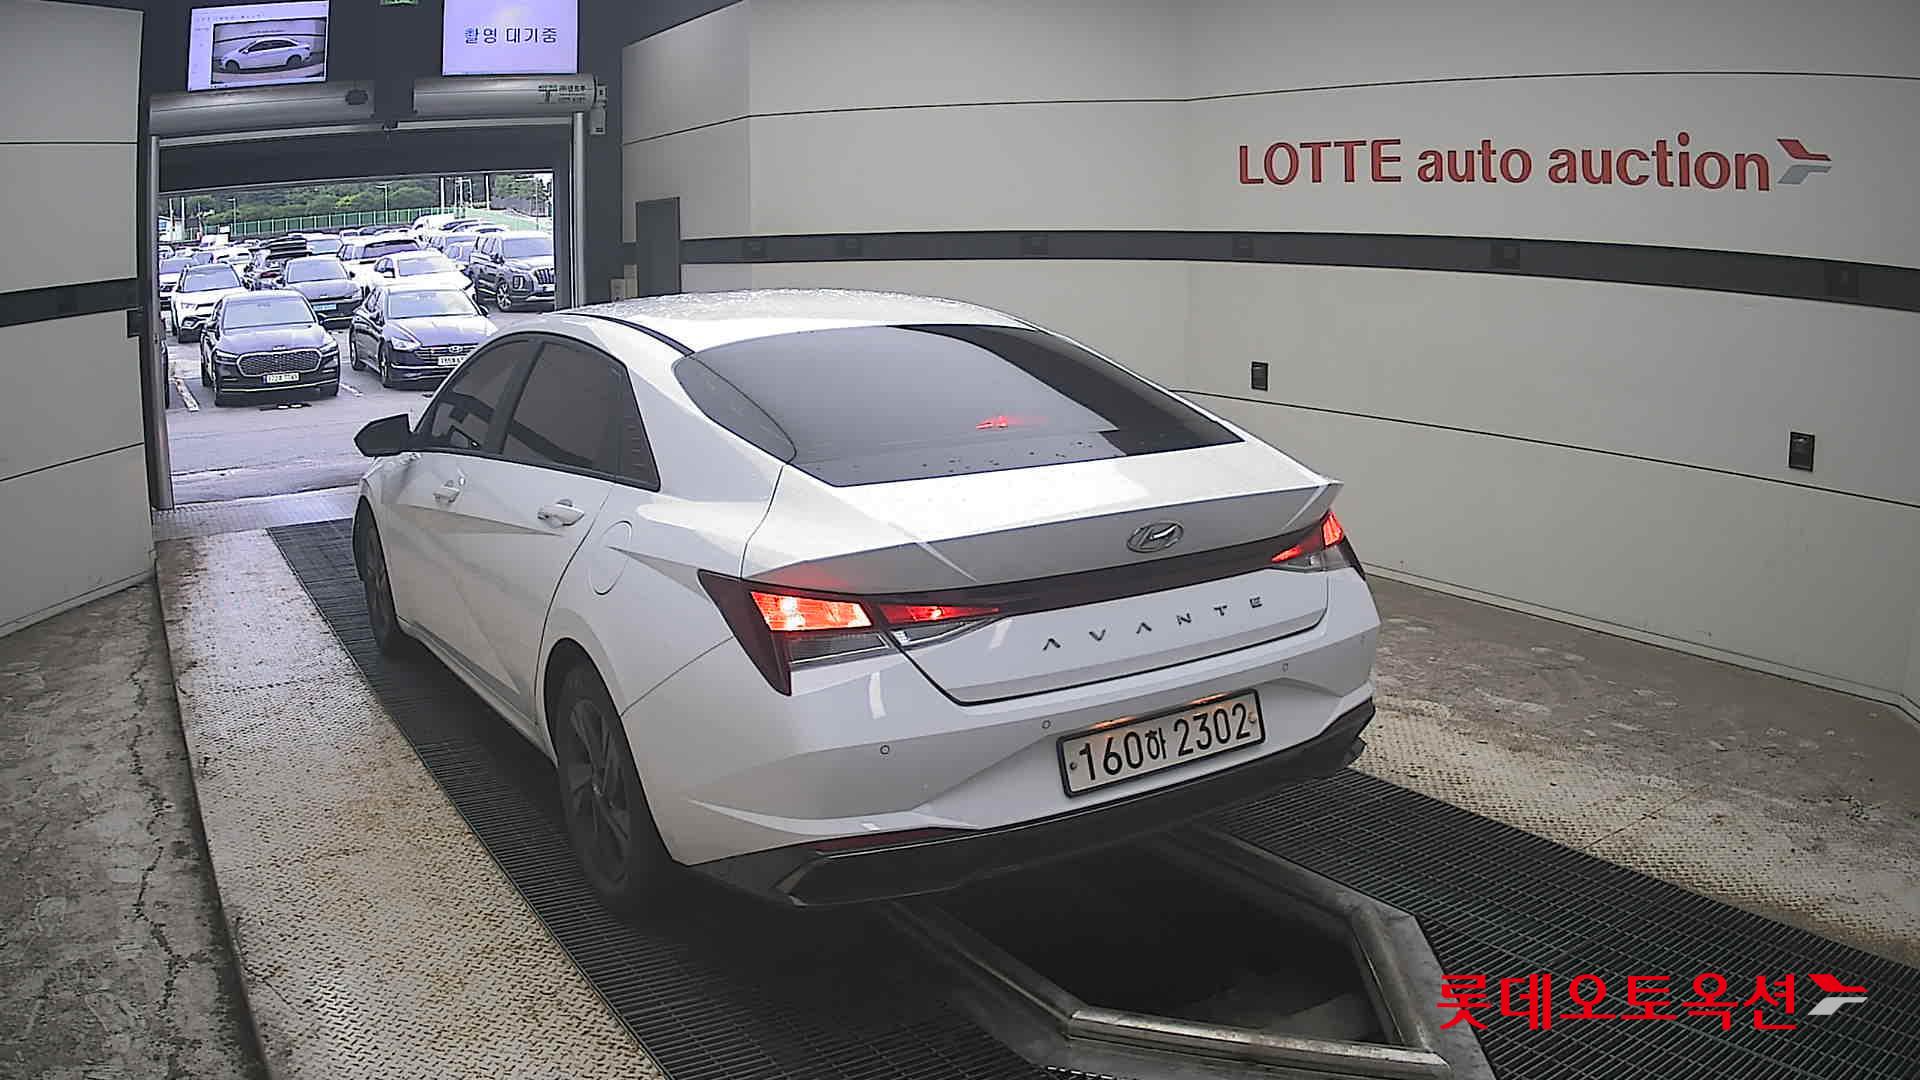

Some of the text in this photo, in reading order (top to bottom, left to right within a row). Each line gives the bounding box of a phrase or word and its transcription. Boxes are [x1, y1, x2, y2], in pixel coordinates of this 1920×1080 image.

[506, 27, 557, 43] 대기중
[1239, 132, 1770, 191] LOTTE auto auction
[1042, 596, 1263, 651] AVANTE
[1079, 702, 1251, 781] 160하 2302
